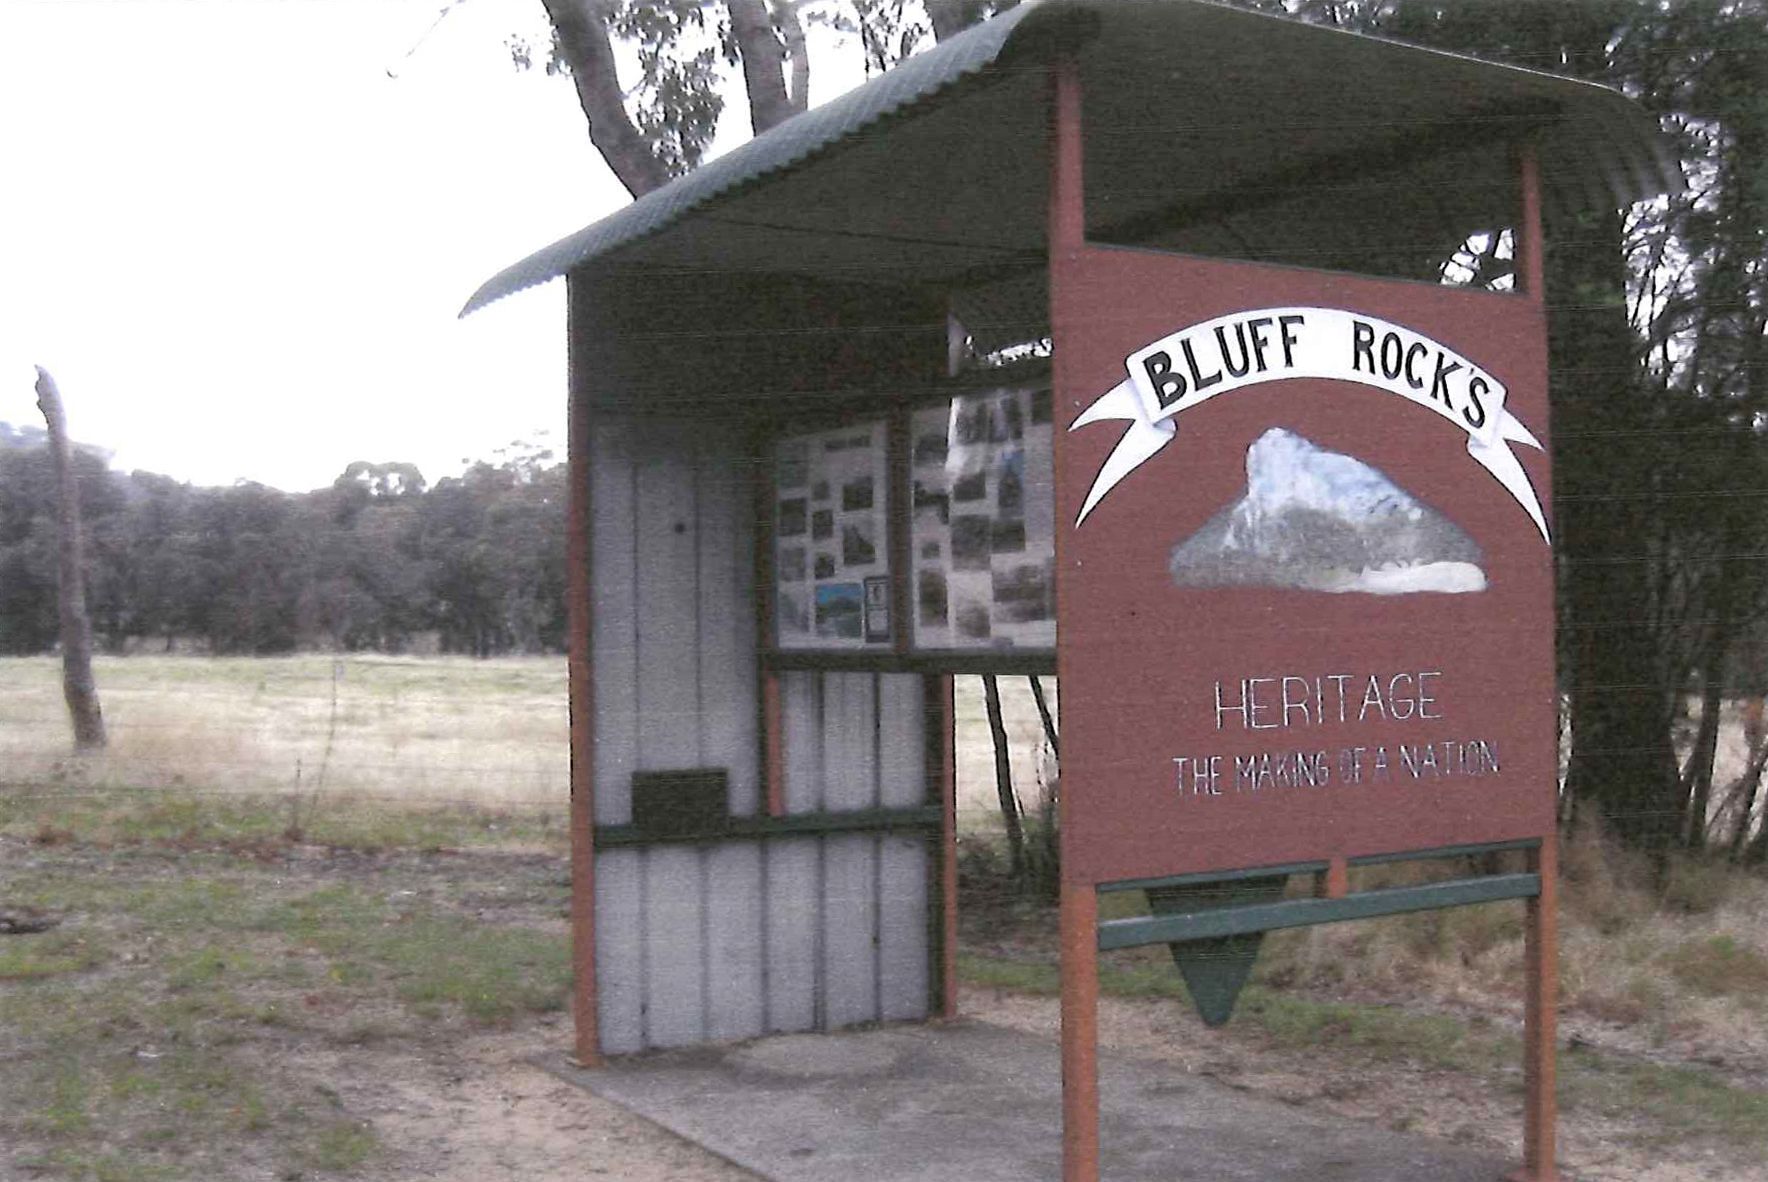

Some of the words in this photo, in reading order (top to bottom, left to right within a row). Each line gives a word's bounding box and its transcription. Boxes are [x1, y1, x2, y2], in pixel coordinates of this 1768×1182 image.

[1142, 315, 1305, 410] BLUFF
[1352, 320, 1491, 429] ROCK'S
[1214, 671, 1443, 730] HERITAGE
[1173, 756, 1222, 796] THE
[1234, 751, 1329, 792] MAKING
[1339, 747, 1366, 785] OF
[1373, 746, 1391, 784] A
[1399, 740, 1500, 778] NATION
